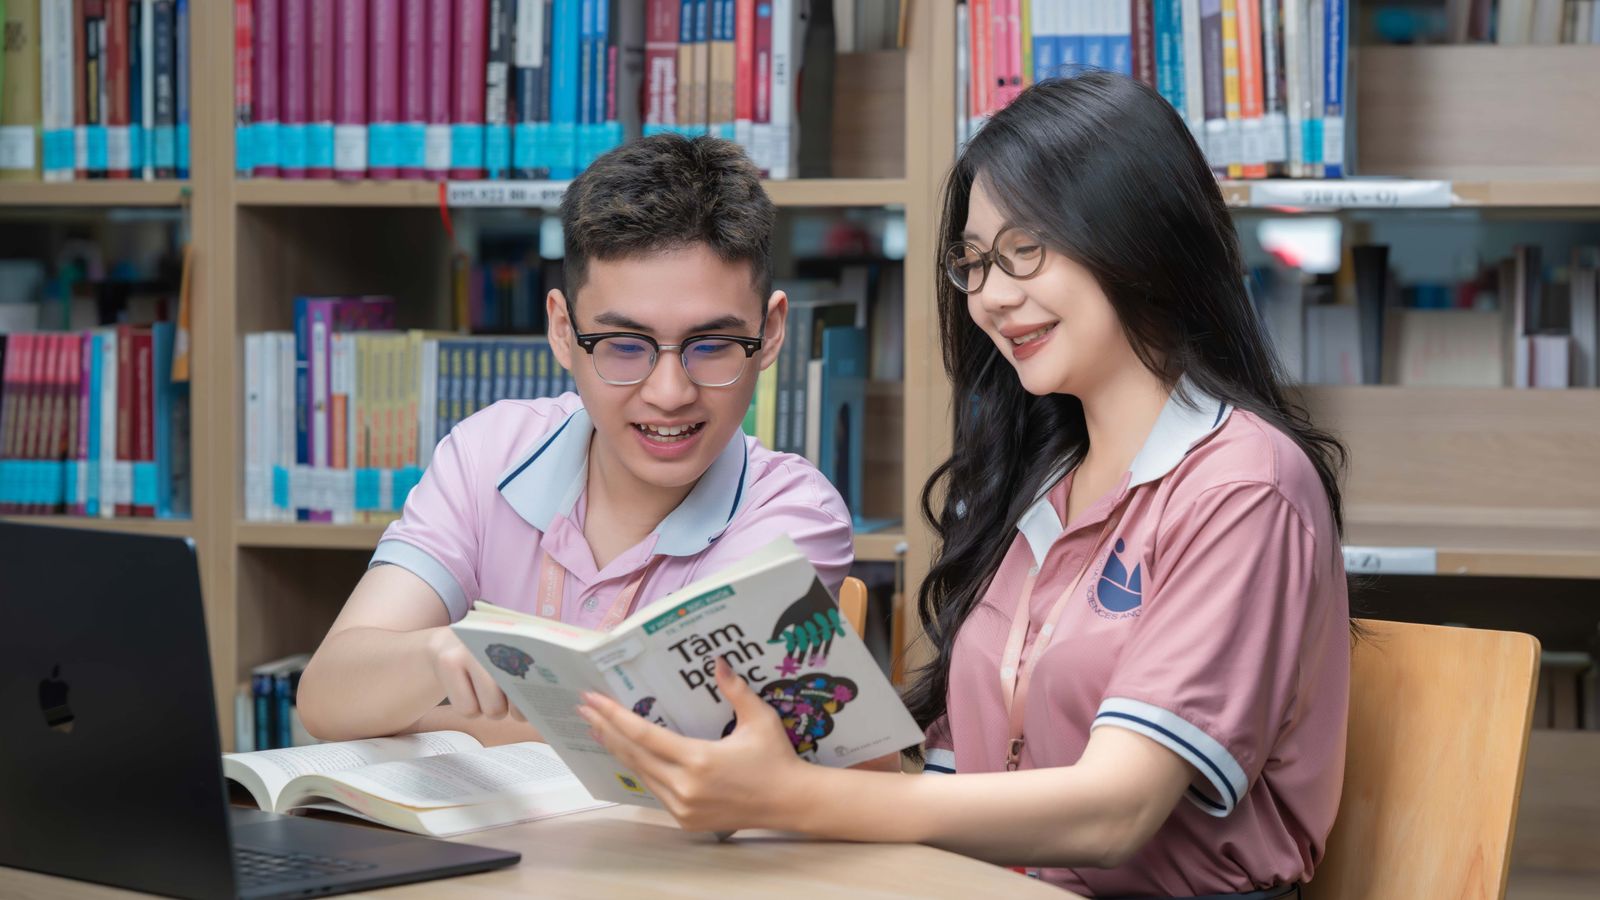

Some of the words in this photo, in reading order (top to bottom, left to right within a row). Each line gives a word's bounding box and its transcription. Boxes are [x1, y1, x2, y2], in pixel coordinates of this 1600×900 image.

[1087, 584, 1118, 620] SCIENCES
[668, 622, 745, 663] Tâm
[704, 665, 768, 704] hc
